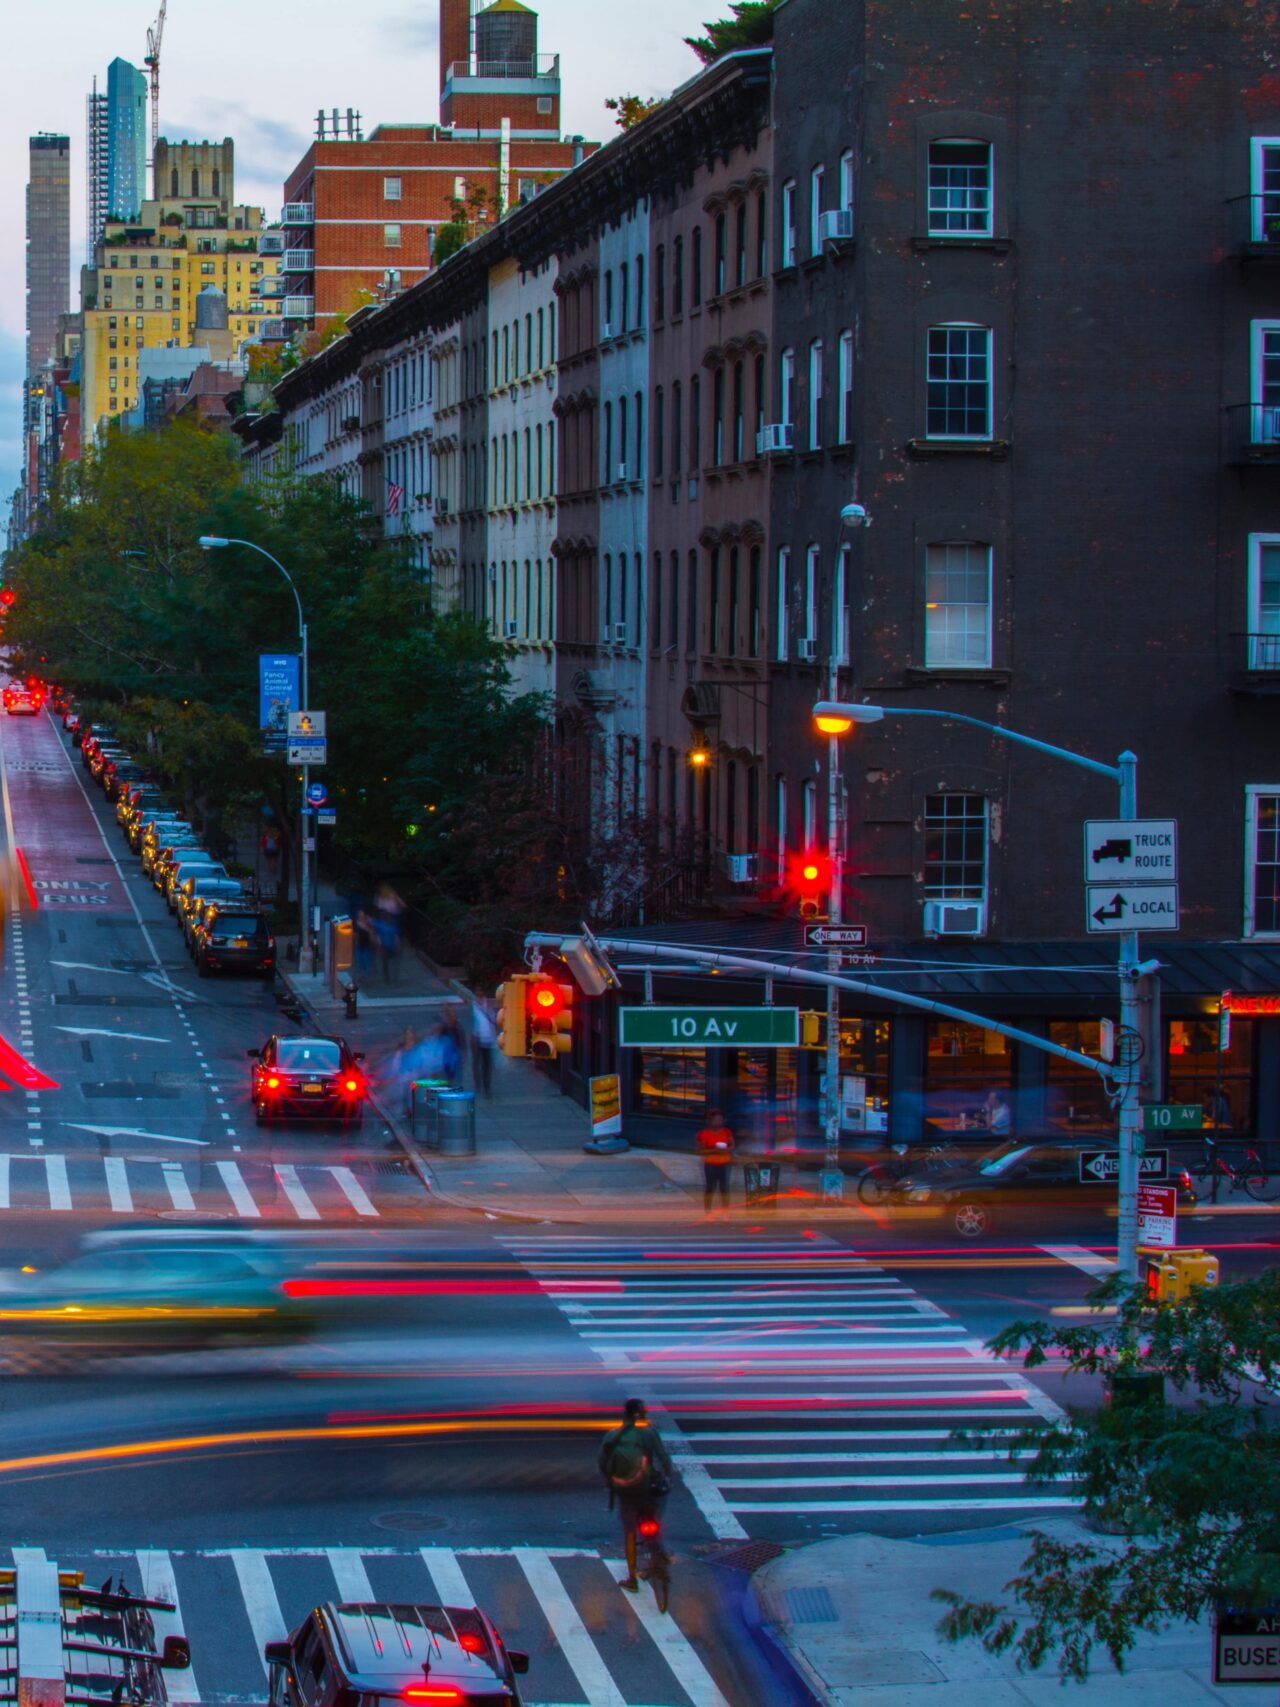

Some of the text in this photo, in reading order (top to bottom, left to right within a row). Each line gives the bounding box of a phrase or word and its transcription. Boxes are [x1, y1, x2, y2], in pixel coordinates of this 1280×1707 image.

[1135, 834, 1172, 846] TRUCK
[1135, 855, 1172, 867] ROUTE
[32, 881, 111, 889] ONLY
[43, 895, 109, 904] BUS
[1132, 901, 1175, 914] LOCAL
[814, 931, 832, 940] ONE
[848, 954, 859, 964] 10
[671, 1018, 738, 1036] 10 Av
[1151, 1109, 1171, 1126] 10
[1094, 1160, 1155, 1173] ONE AY
[1223, 1647, 1280, 1666] BUSE
